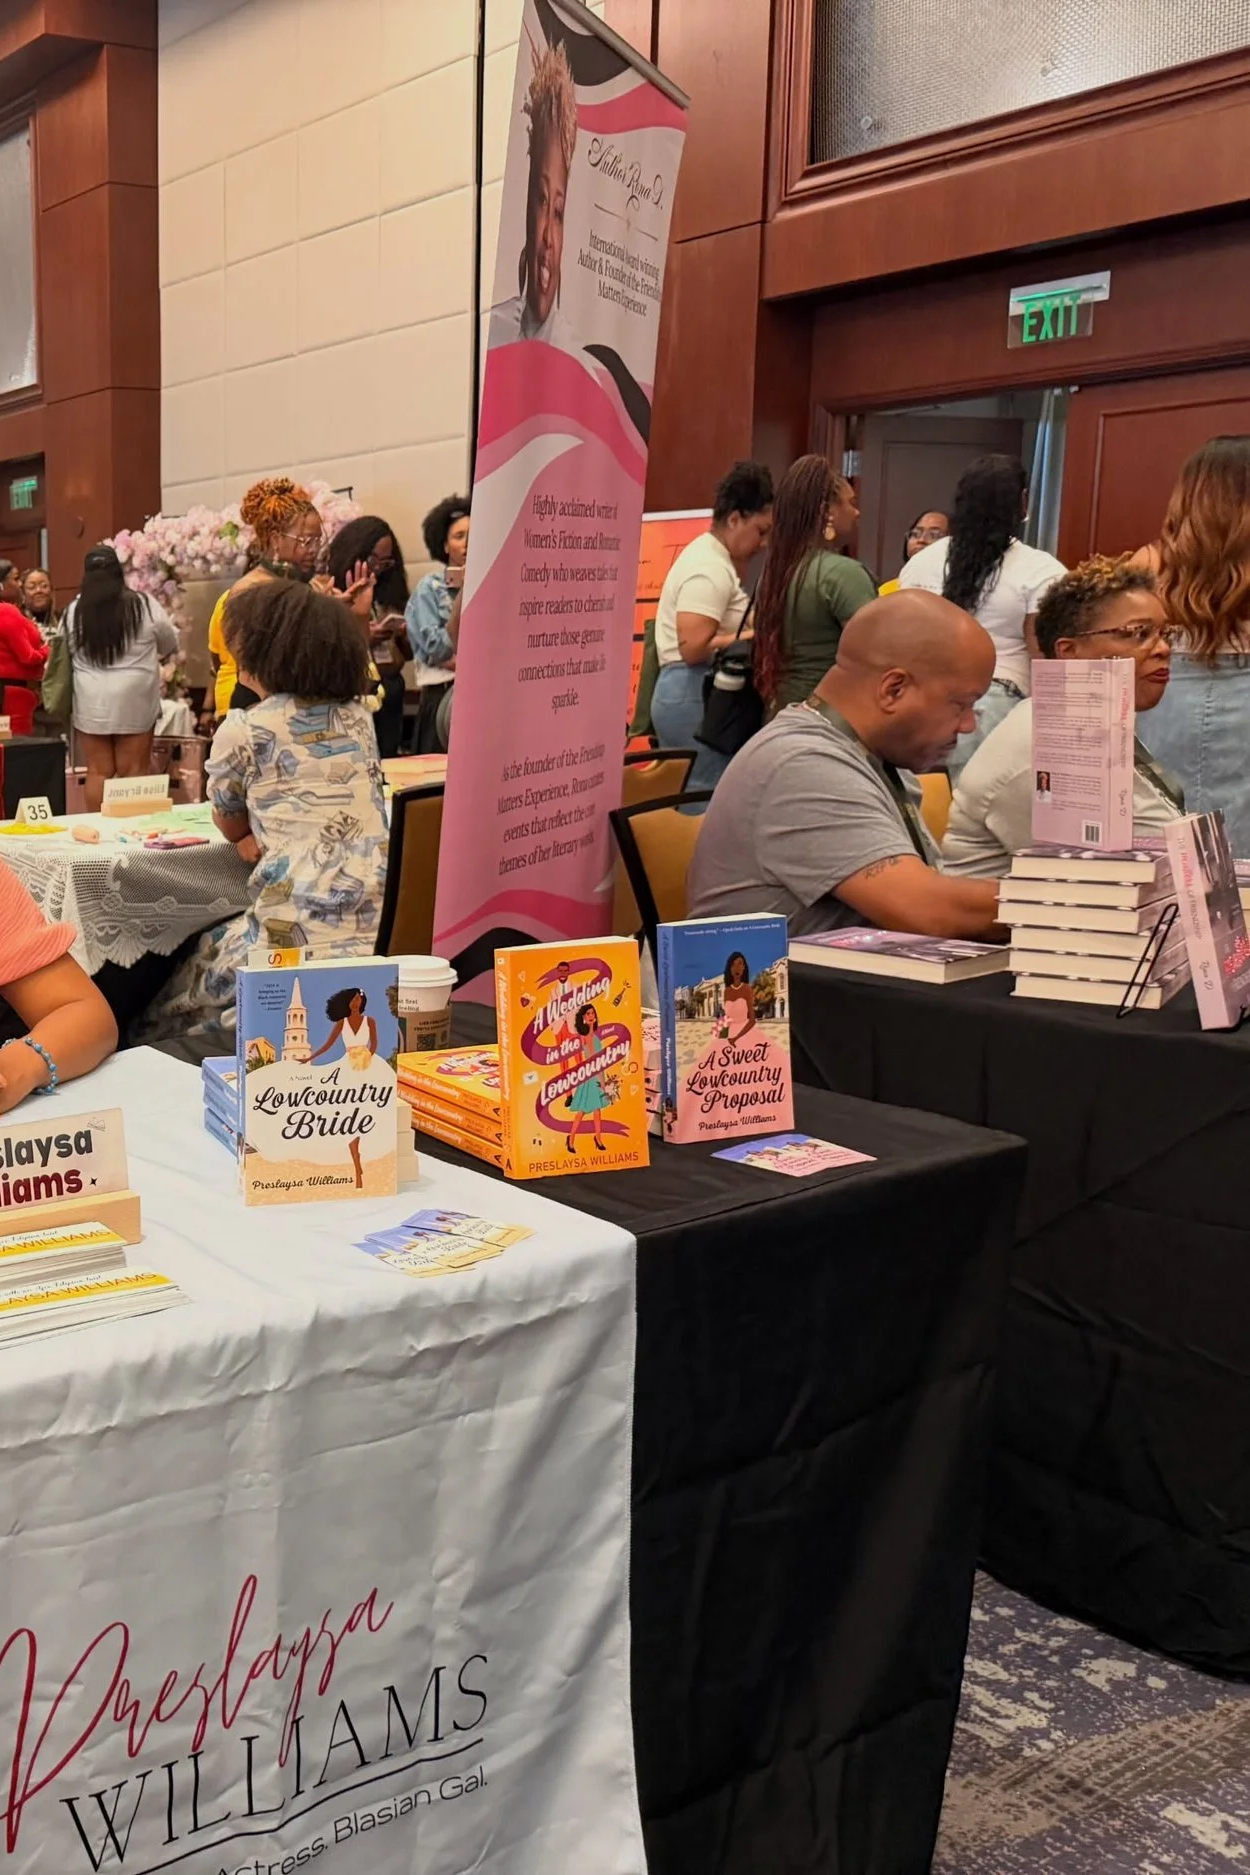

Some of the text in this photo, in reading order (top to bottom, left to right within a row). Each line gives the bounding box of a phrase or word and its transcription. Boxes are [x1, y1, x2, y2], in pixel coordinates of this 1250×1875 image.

[588, 137, 627, 184] Author
[589, 228, 625, 262] International
[577, 247, 640, 293] Author & Founder the
[1022, 293, 1082, 343] EXIT
[532, 495, 559, 522] Highly
[559, 498, 596, 518] acclaimed
[524, 528, 598, 550] Women's Fiction and
[520, 562, 596, 588] Comedy who weaves
[518, 595, 583, 622] inspire readers to
[527, 632, 559, 649] nurture
[560, 626, 581, 646] those
[518, 659, 566, 682] connections
[566, 656, 582, 676] that
[551, 688, 579, 715] sparkle.
[510, 748, 579, 779] the founder of the
[524, 784, 570, 810] Experience,
[27, 803, 49, 821] 35
[503, 806, 585, 844] events that reflect the
[498, 840, 578, 876] themes of her literary
[532, 976, 611, 1034] A Wedding
[546, 1031, 581, 1065] in the
[698, 1042, 771, 1071] A Sweet
[319, 1067, 341, 1086] A
[541, 1041, 630, 1106] Lowcountry
[686, 1066, 782, 1096] Lowcountry
[252, 1084, 394, 1116] Lowcountry
[700, 1083, 785, 1114] Proposal
[281, 1108, 376, 1140] Bride
[698, 1115, 777, 1131] Preslaysa Williams
[529, 1151, 639, 1174] PRESLAYSA WILLIAMS
[252, 1175, 354, 1191] Preslaysa Williams
[17, 1229, 111, 1251] WILLIAMS
[59, 1272, 157, 1296] WILLIAMS
[59, 1655, 488, 1873] WILLIAMS
[218, 1765, 488, 1874] tress. Blasian Gal.
